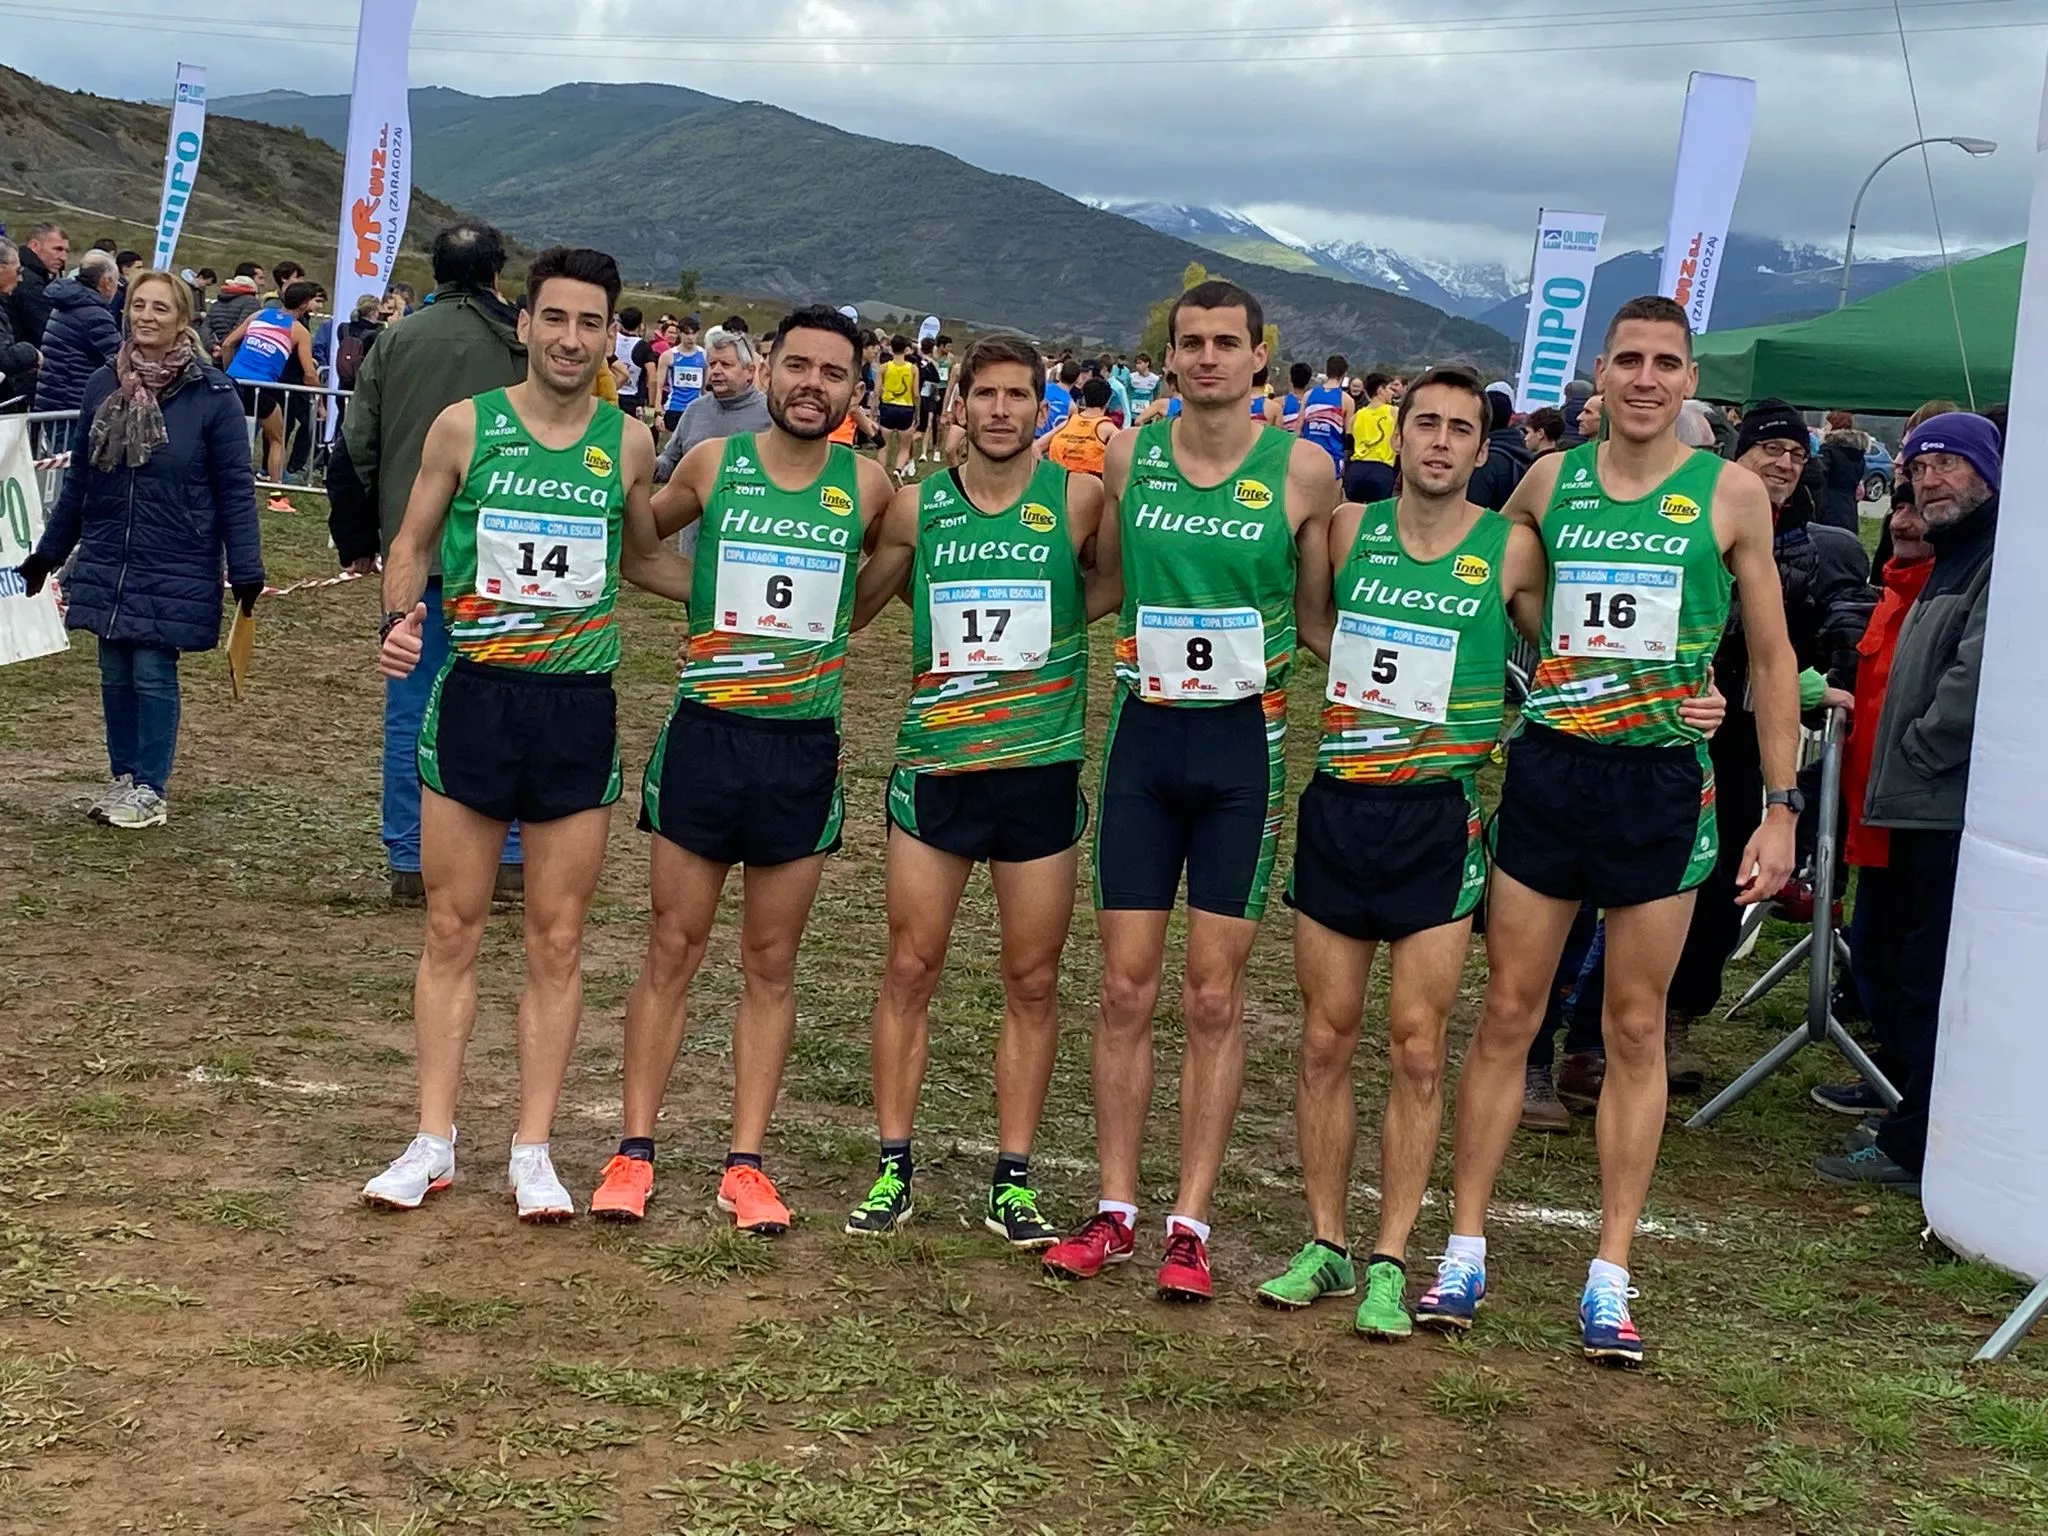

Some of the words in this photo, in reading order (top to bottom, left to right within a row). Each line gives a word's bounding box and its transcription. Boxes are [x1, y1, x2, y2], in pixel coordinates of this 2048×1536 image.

[390, 127, 403, 212] (ZARAGOZA)
[1693, 236, 1719, 322] (ZARAGOZA)
[1526, 277, 1586, 405] IMPO
[487, 471, 608, 508] Huesca
[485, 517, 506, 530] COPA
[547, 524, 569, 536] COPA
[570, 525, 602, 538] ESCOLAR
[720, 508, 849, 547] Huesca
[1135, 503, 1265, 541] Huesca
[934, 540, 1050, 567] Huesca
[1556, 524, 1690, 556] Huesca
[516, 542, 569, 579] 14
[726, 549, 745, 561] COPA
[785, 555, 805, 568] COPA
[806, 557, 838, 571] ESCOLAR
[766, 574, 793, 609] 6
[987, 588, 1008, 600] COPA
[1009, 588, 1044, 600] ESCOLAR
[1614, 571, 1635, 583] COPA
[1637, 572, 1675, 585] ESCOLAR
[1351, 577, 1481, 617] Huesca
[1583, 592, 1637, 629] 16
[962, 609, 1011, 643] 17
[1143, 614, 1163, 626] COPA
[1201, 617, 1222, 628] COPA
[1222, 615, 1257, 628] ESCOLAR
[1186, 636, 1213, 671] 8
[1393, 630, 1414, 643] COPA
[1414, 633, 1451, 649] ESCOLAR
[1371, 648, 1399, 684] 5
